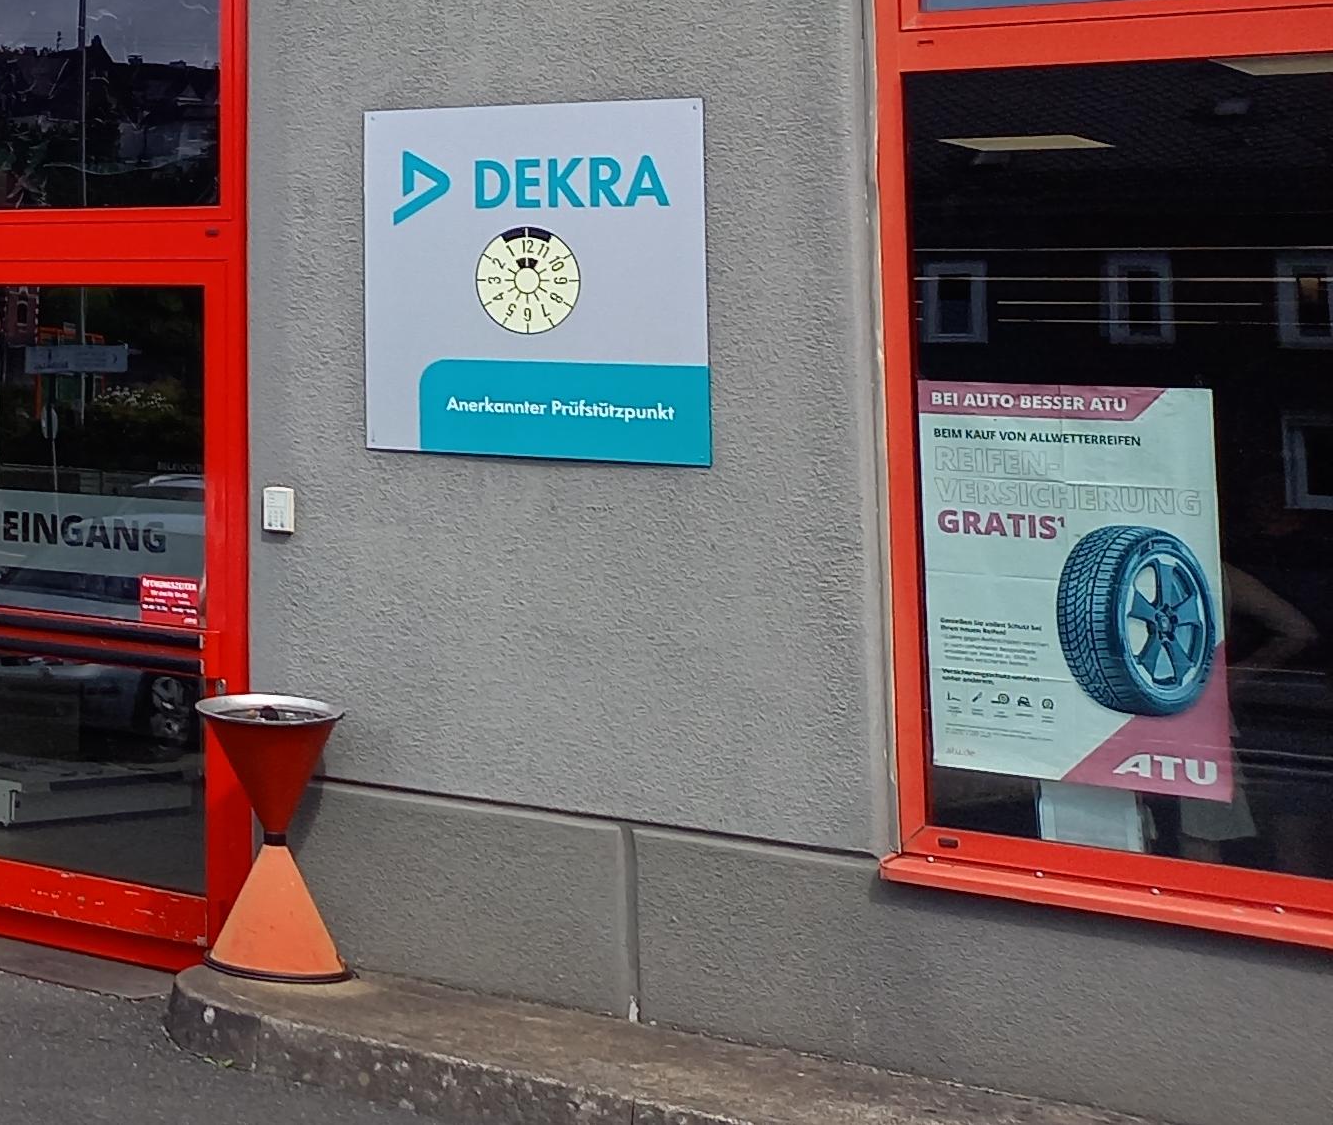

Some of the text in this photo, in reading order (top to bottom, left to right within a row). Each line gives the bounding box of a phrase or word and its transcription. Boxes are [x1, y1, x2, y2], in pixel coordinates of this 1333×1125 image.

[474, 154, 670, 210] DEKRA
[506, 244, 515, 257] 1
[521, 239, 534, 254] 12
[537, 243, 550, 258] 11
[492, 257, 505, 269] 2
[549, 255, 565, 272] 10
[488, 276, 501, 284] 3
[554, 276, 568, 285] 9
[492, 292, 504, 301] 4
[550, 292, 563, 303] 8
[506, 303, 517, 317] 5
[524, 307, 531, 322] 6
[541, 303, 551, 317] 7
[446, 396, 676, 422] Anerkannter Prüfstützpunkt
[931, 391, 1127, 412] BEI AUTO BESSER ATU
[934, 427, 1141, 446] BEIM KAUF VON ALLWETTERREIFEN
[934, 446, 1060, 475] REIFEN-
[933, 477, 1202, 516] VERSICHERUNG
[3, 510, 166, 553] EINGANG
[1112, 753, 1218, 786] ATU
